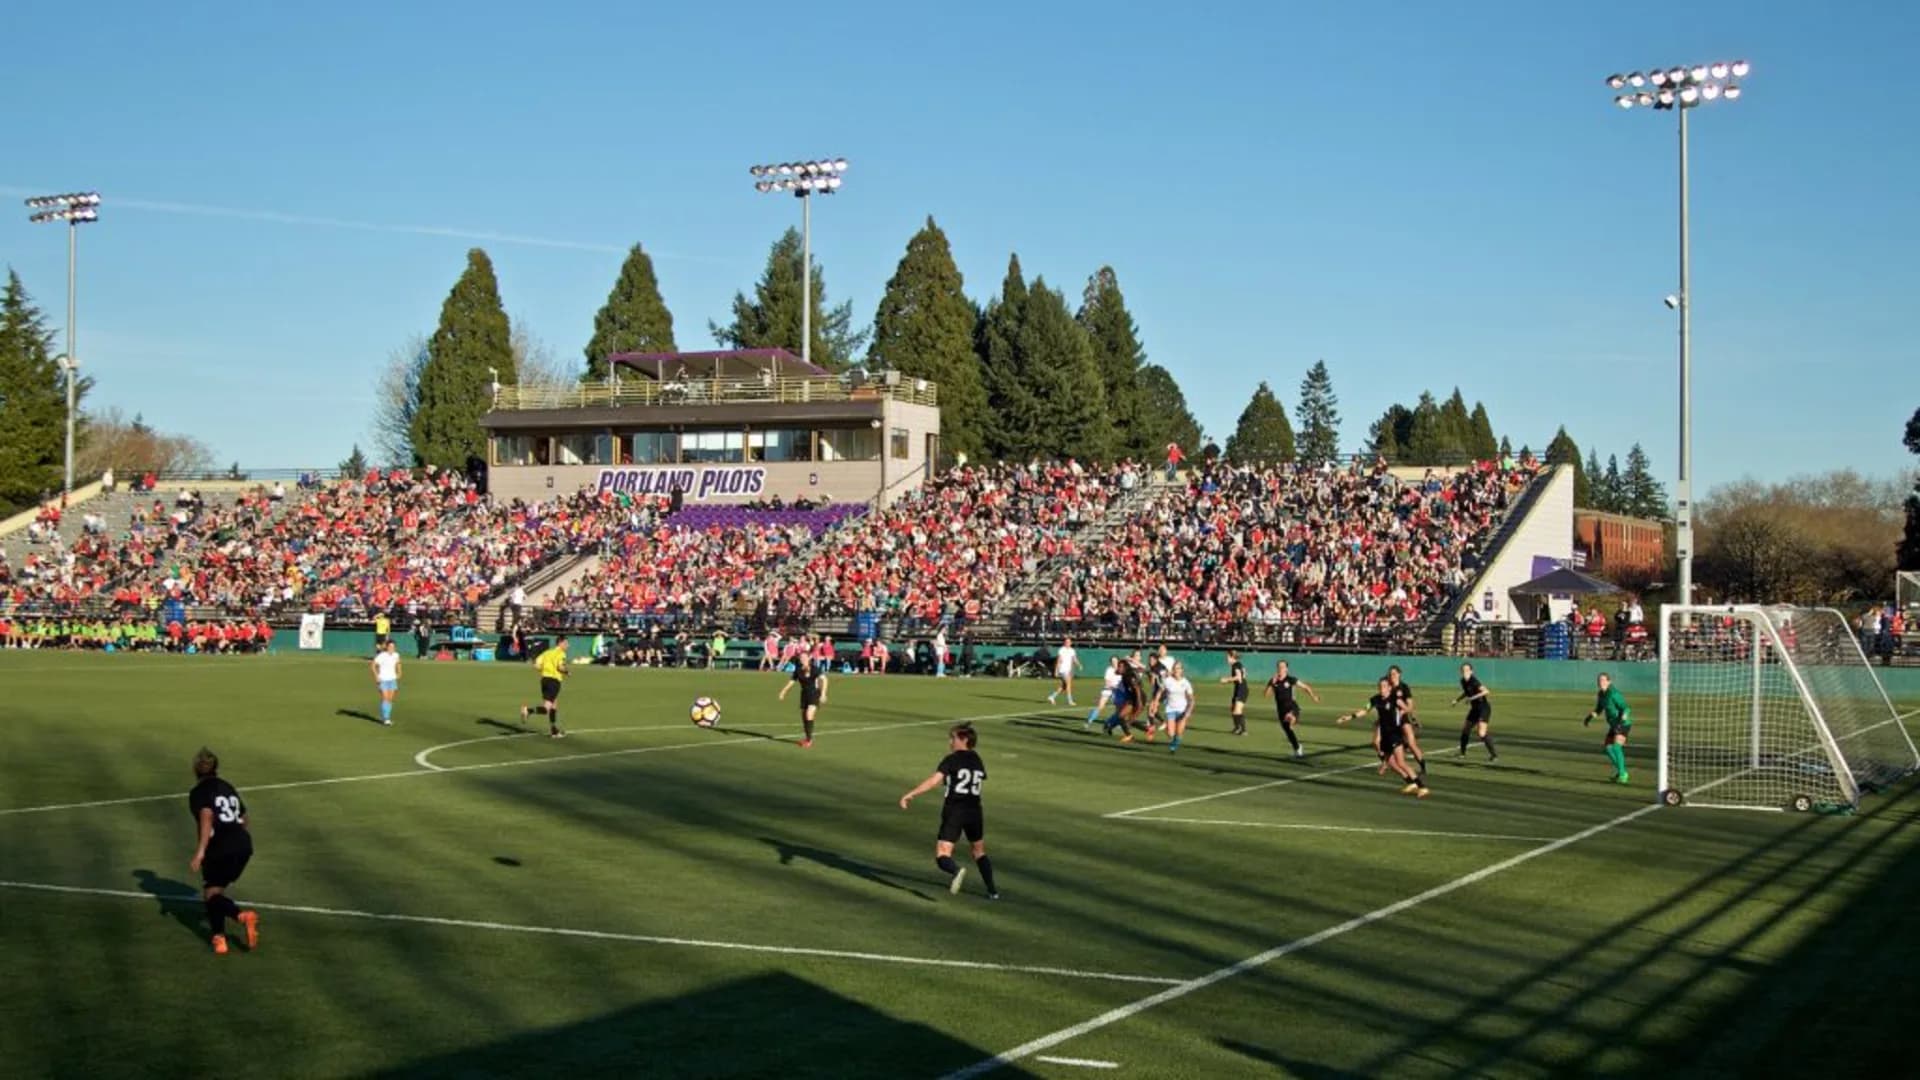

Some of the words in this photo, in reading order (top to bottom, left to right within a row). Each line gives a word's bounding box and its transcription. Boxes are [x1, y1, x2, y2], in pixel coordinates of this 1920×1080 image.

[599, 470, 695, 495] PORTLAND
[698, 469, 764, 498] PILOTS
[955, 767, 985, 796] 25
[214, 795, 244, 824] 32
